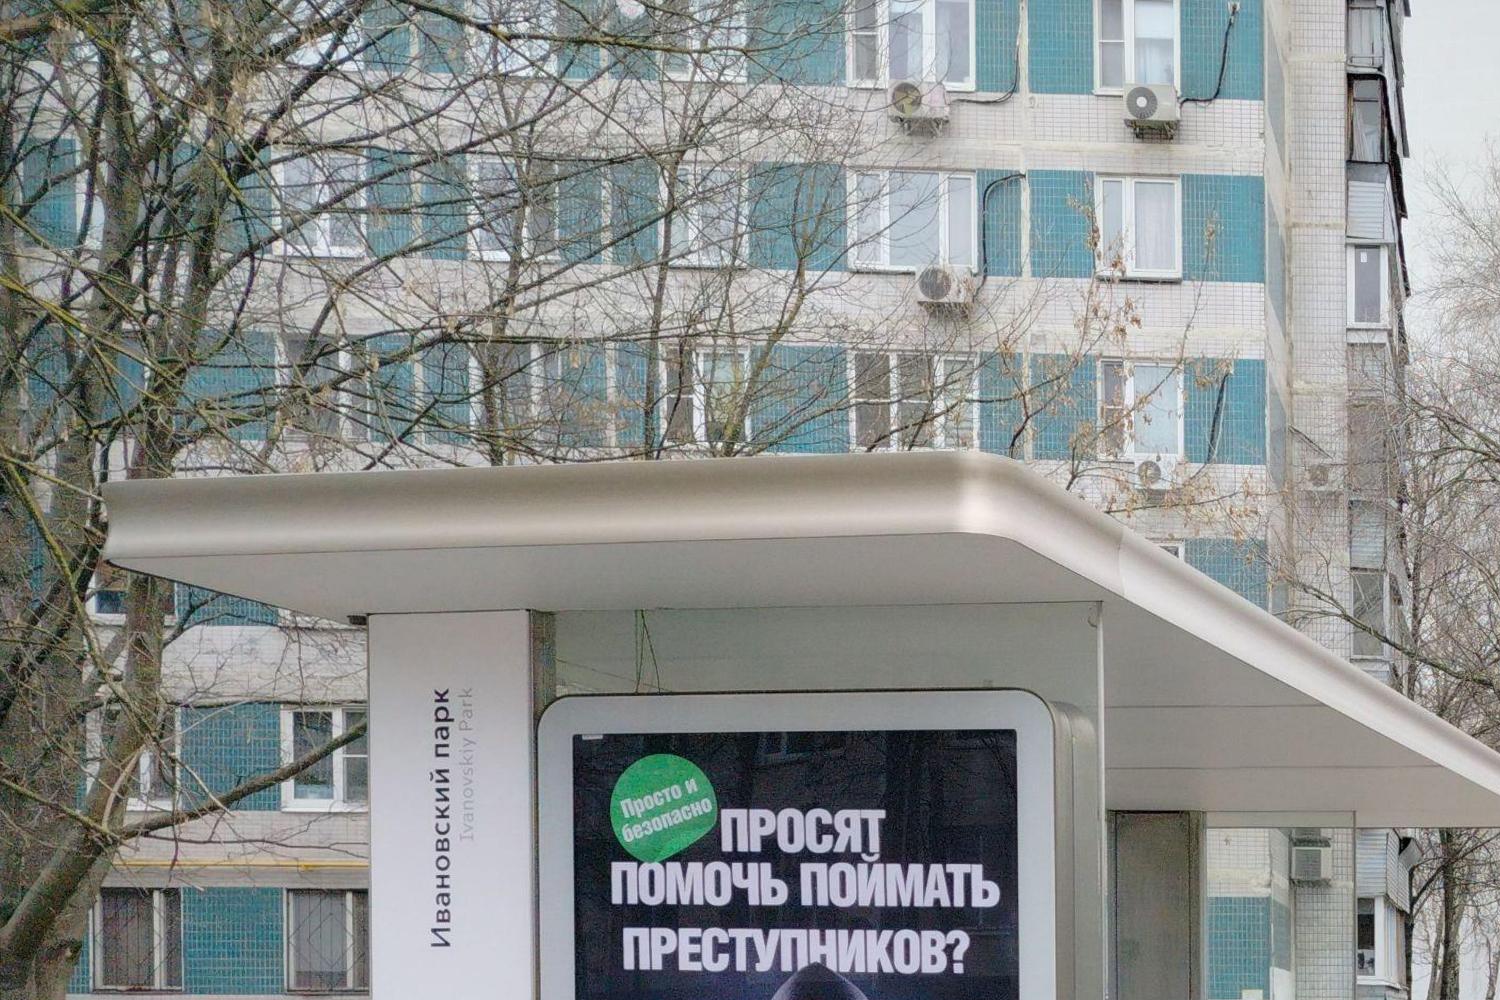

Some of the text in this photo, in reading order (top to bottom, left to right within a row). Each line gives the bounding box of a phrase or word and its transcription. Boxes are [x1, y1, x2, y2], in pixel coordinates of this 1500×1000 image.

[458, 687, 477, 842] Ivanovskiy Park
[430, 687, 455, 947] Ивановский парк
[620, 778, 698, 818] Просто и
[622, 798, 713, 842] безопасно
[720, 808, 886, 853] ПРОСЯТ
[611, 853, 1001, 908] ПОМОЧЬ ПОЙМАТЬ
[622, 927, 970, 975] ПРЕСТУПНИКОВ?
